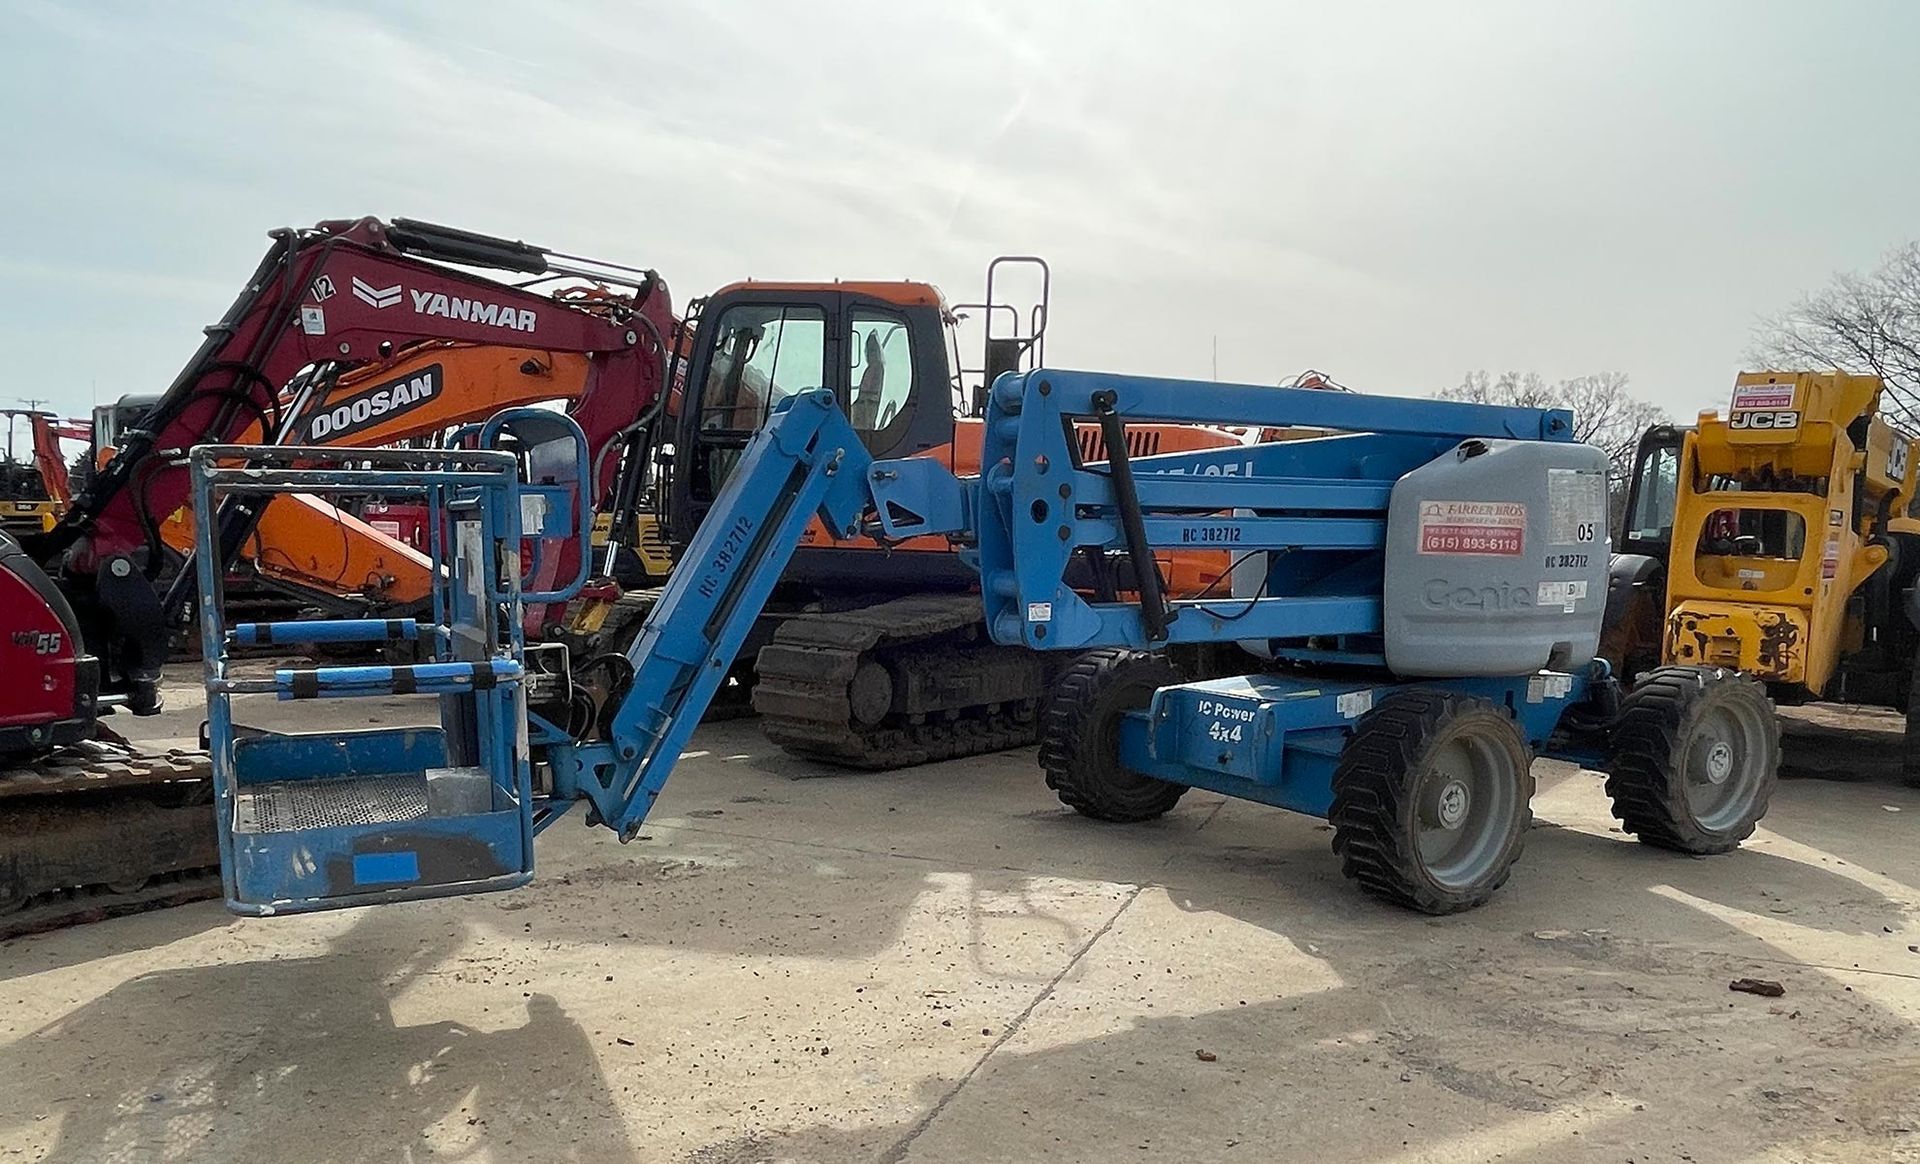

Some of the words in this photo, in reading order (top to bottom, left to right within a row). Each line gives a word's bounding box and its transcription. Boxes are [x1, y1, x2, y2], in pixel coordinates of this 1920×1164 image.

[410, 289, 537, 332] YANMAR
[311, 373, 433, 440] DOOSAN
[1731, 412, 1798, 428] JCB
[1182, 527, 1197, 542] RC
[1202, 527, 1241, 542] 382712
[1578, 523, 1594, 541] 05
[712, 516, 754, 574] 382712
[1427, 536, 1459, 549] (615)
[1462, 537, 1518, 551] 893-6118
[1558, 555, 1589, 568] 382712
[1422, 578, 1533, 610] Genie
[1214, 702, 1256, 722] Power
[1208, 721, 1242, 744] 4x4
